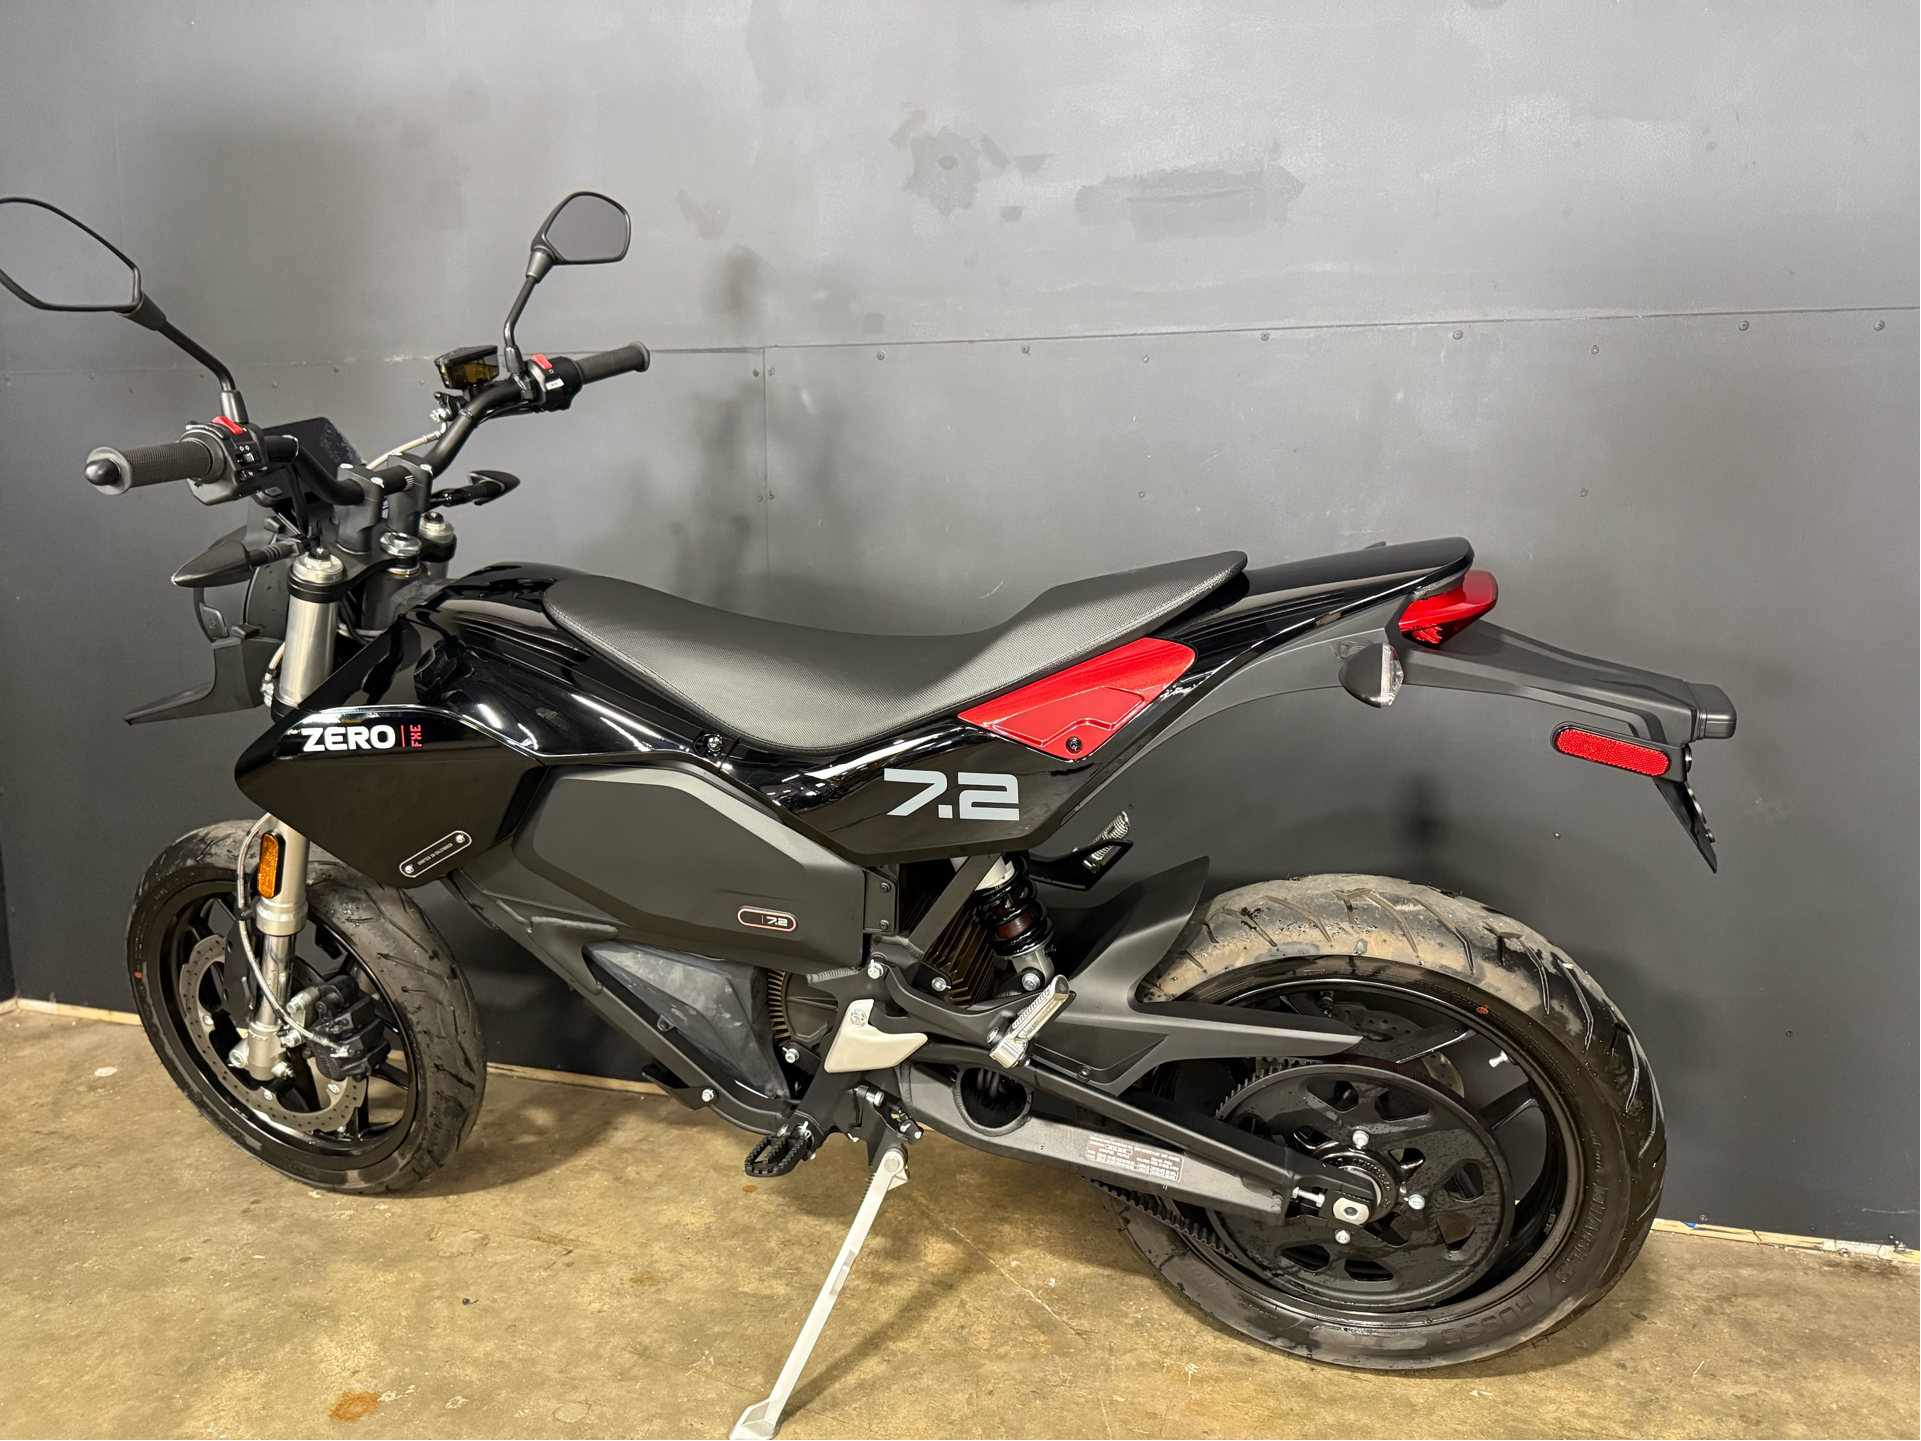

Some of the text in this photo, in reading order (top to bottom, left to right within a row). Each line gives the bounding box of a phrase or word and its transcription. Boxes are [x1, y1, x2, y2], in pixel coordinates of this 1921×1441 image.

[301, 724, 396, 752] ZERO
[409, 724, 423, 748] FXE
[884, 768, 1020, 821] 7.2
[766, 915, 788, 927] 7.2
